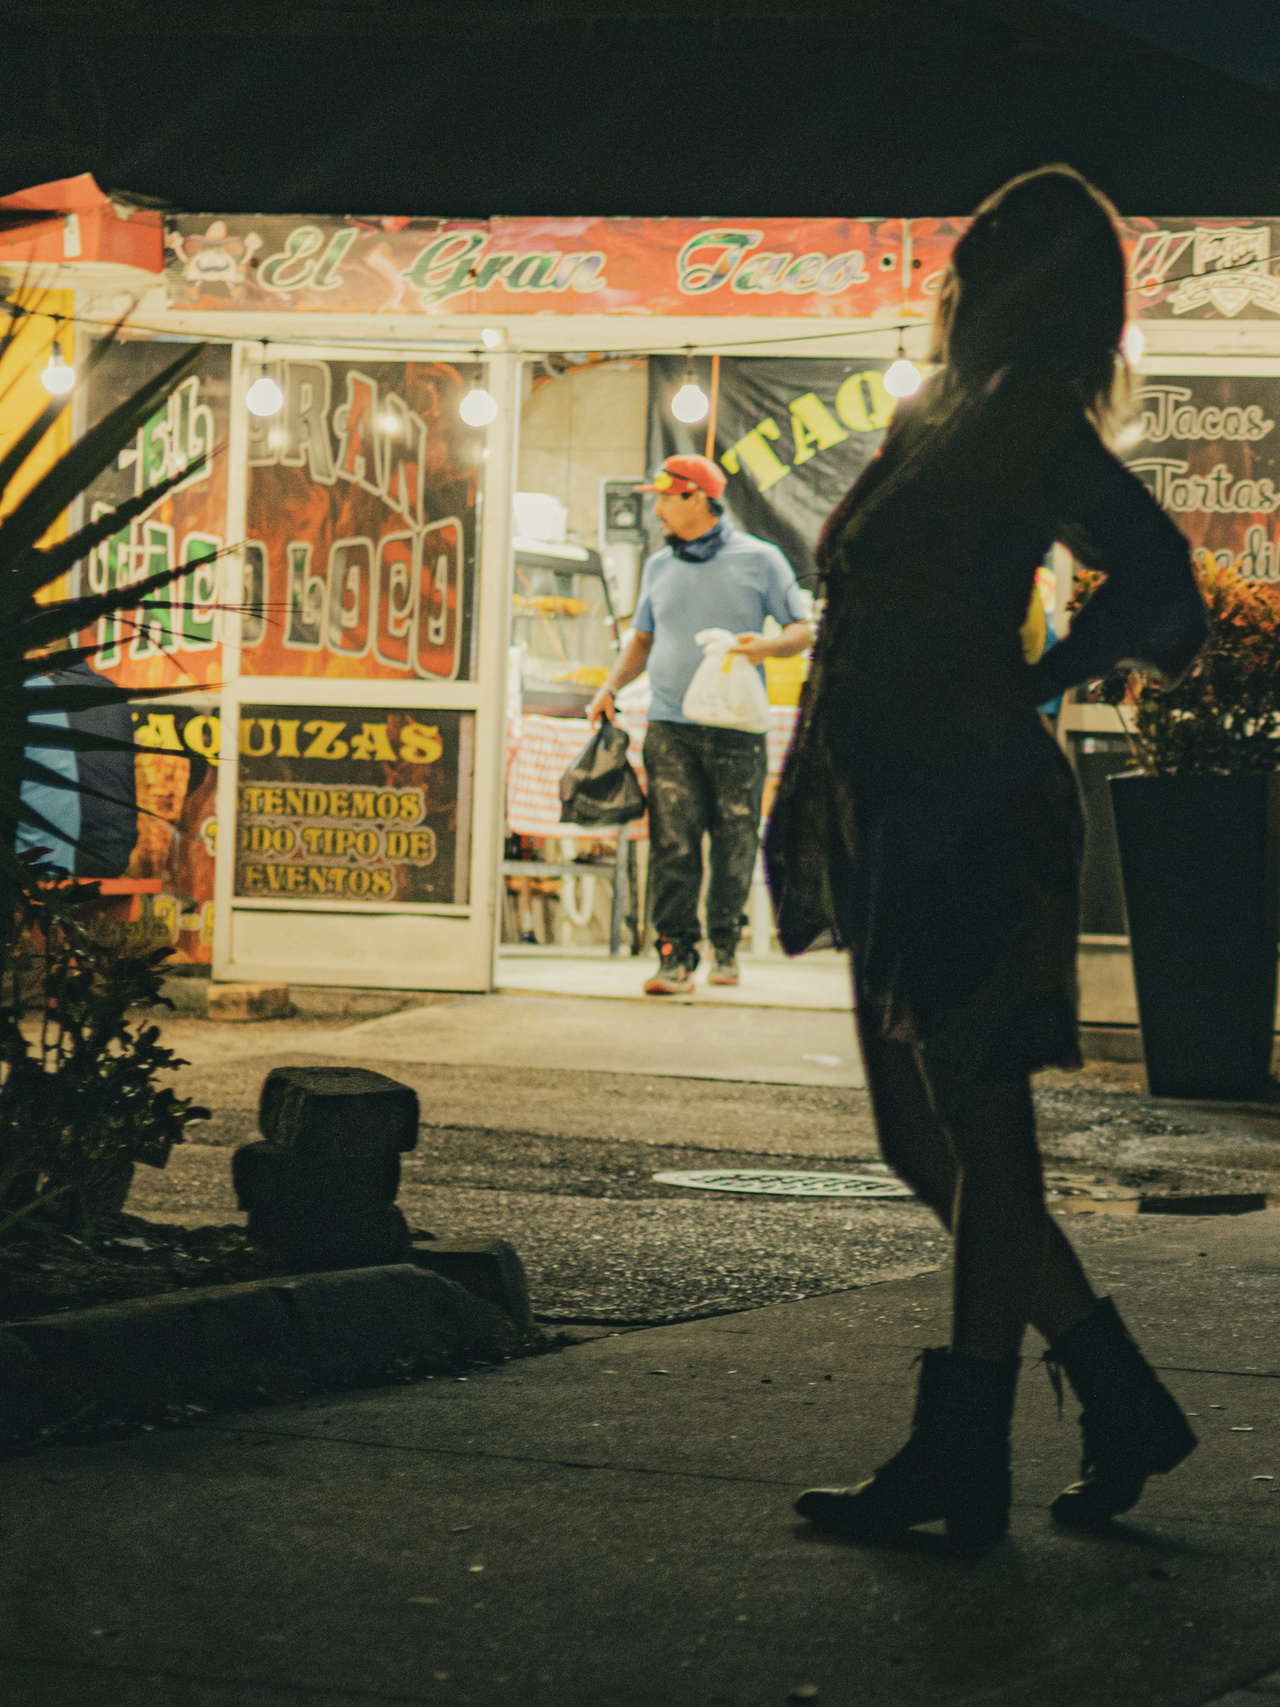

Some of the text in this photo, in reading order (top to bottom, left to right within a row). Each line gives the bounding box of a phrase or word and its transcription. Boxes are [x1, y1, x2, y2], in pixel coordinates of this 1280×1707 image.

[256, 225, 361, 291] El
[400, 228, 608, 310] Gran
[676, 228, 869, 296] Taco
[1132, 384, 1276, 443] Tacos
[131, 712, 444, 766] AQUIZAS
[238, 786, 422, 821] TENDEMOS
[302, 826, 381, 857] TIPO
[387, 832, 433, 861] DE
[245, 864, 393, 897] EVENTOS
